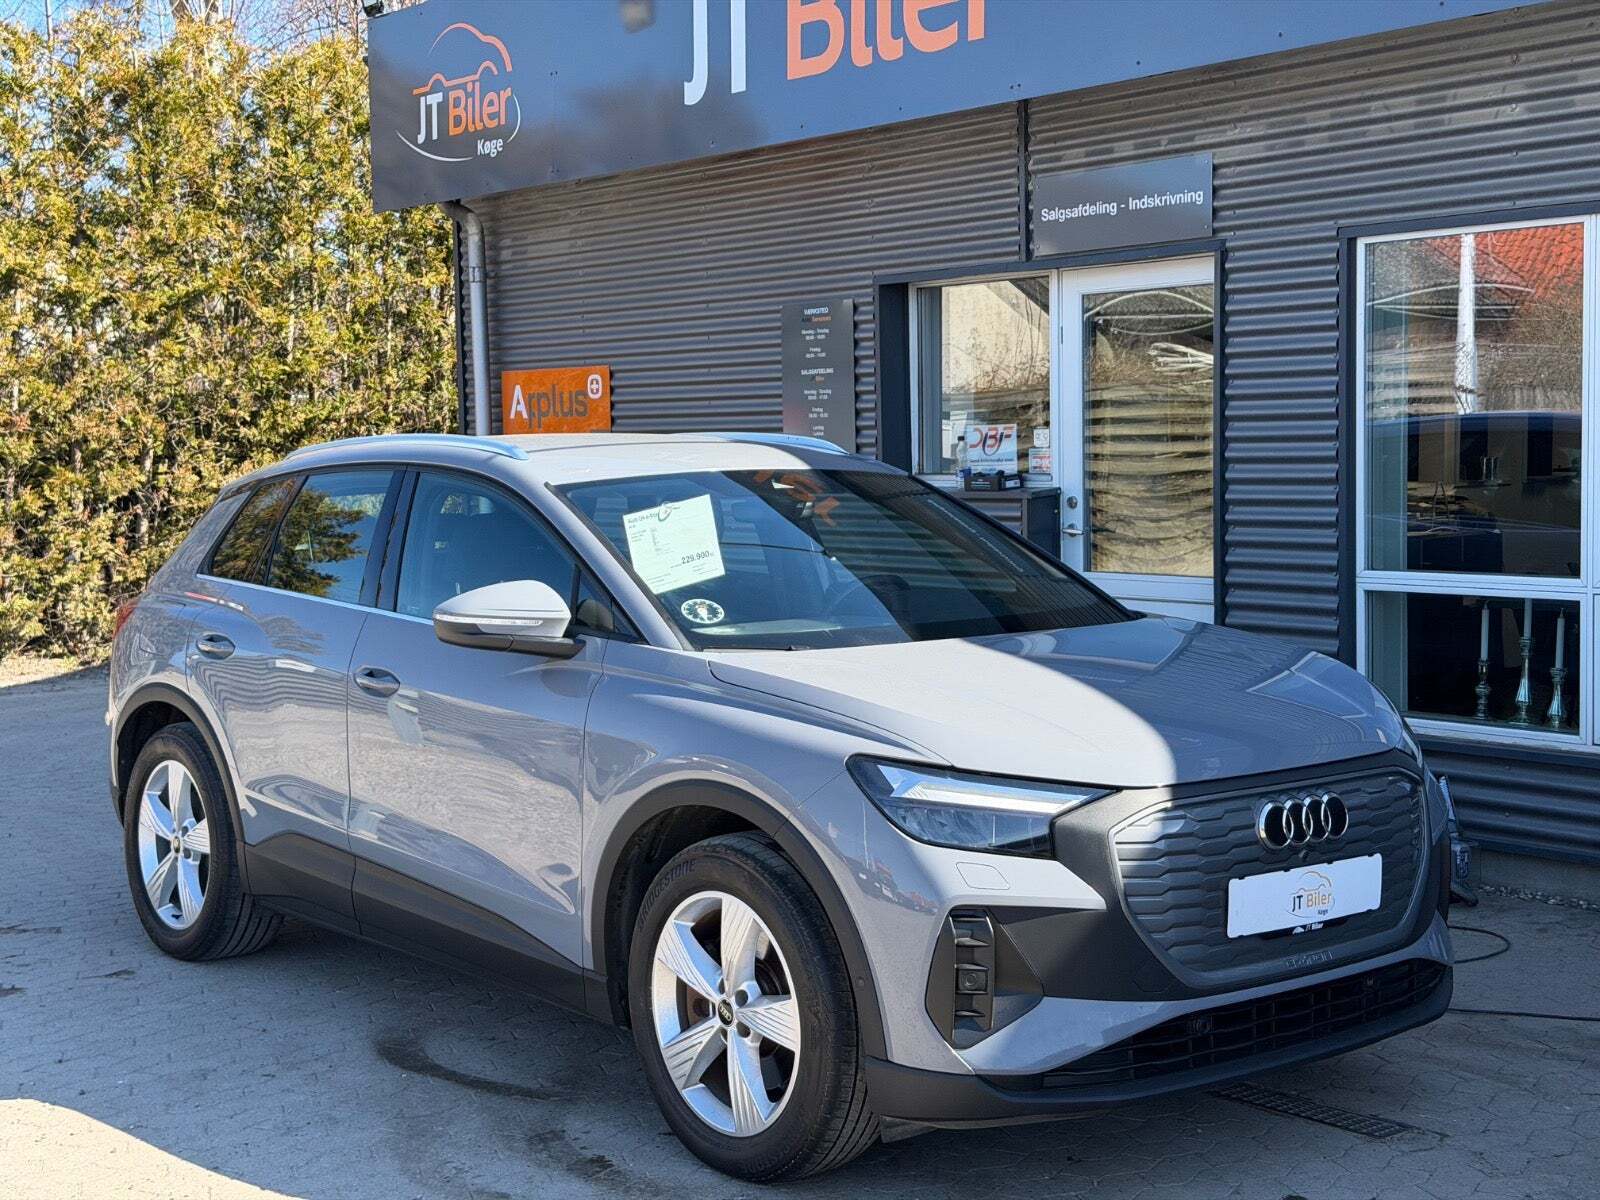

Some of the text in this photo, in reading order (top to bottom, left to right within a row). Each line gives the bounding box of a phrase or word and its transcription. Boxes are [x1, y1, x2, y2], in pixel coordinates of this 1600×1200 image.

[683, 0, 747, 106] JT
[417, 81, 512, 145] JT Biler
[477, 138, 503, 158] Køge
[1041, 201, 1118, 222] Salgsafdeling
[1129, 190, 1204, 211] Indskrivning
[1292, 891, 1332, 912] JT Biler
